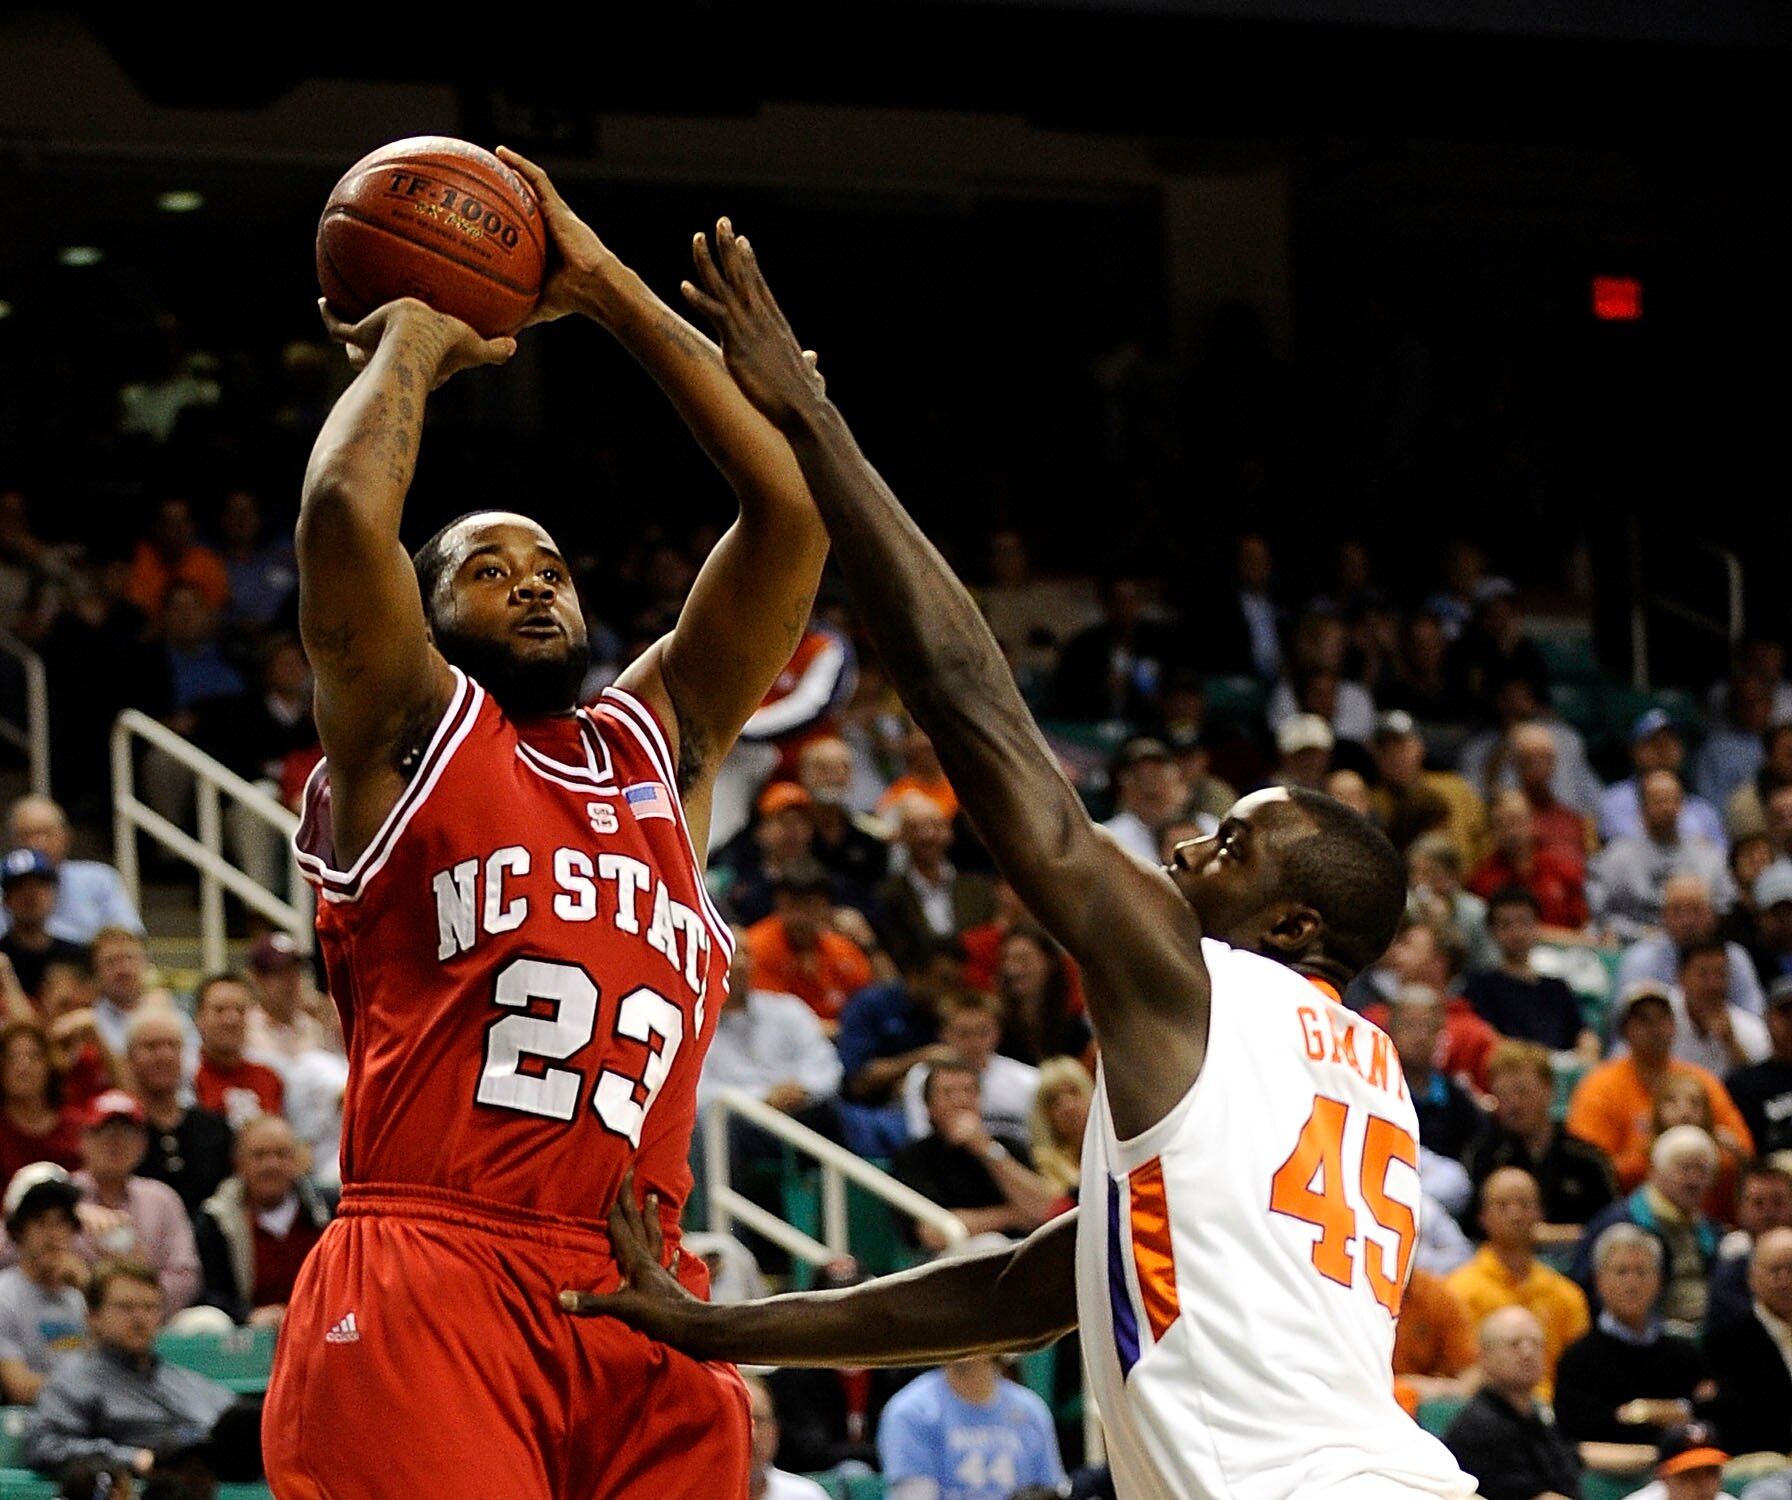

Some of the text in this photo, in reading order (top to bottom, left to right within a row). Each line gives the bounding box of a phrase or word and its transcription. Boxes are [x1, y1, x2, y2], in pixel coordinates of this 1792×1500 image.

[389, 172, 519, 249] TF-1000
[433, 845, 531, 961] NC
[476, 957, 683, 1150] 23
[1268, 1093, 1417, 1319] 45
